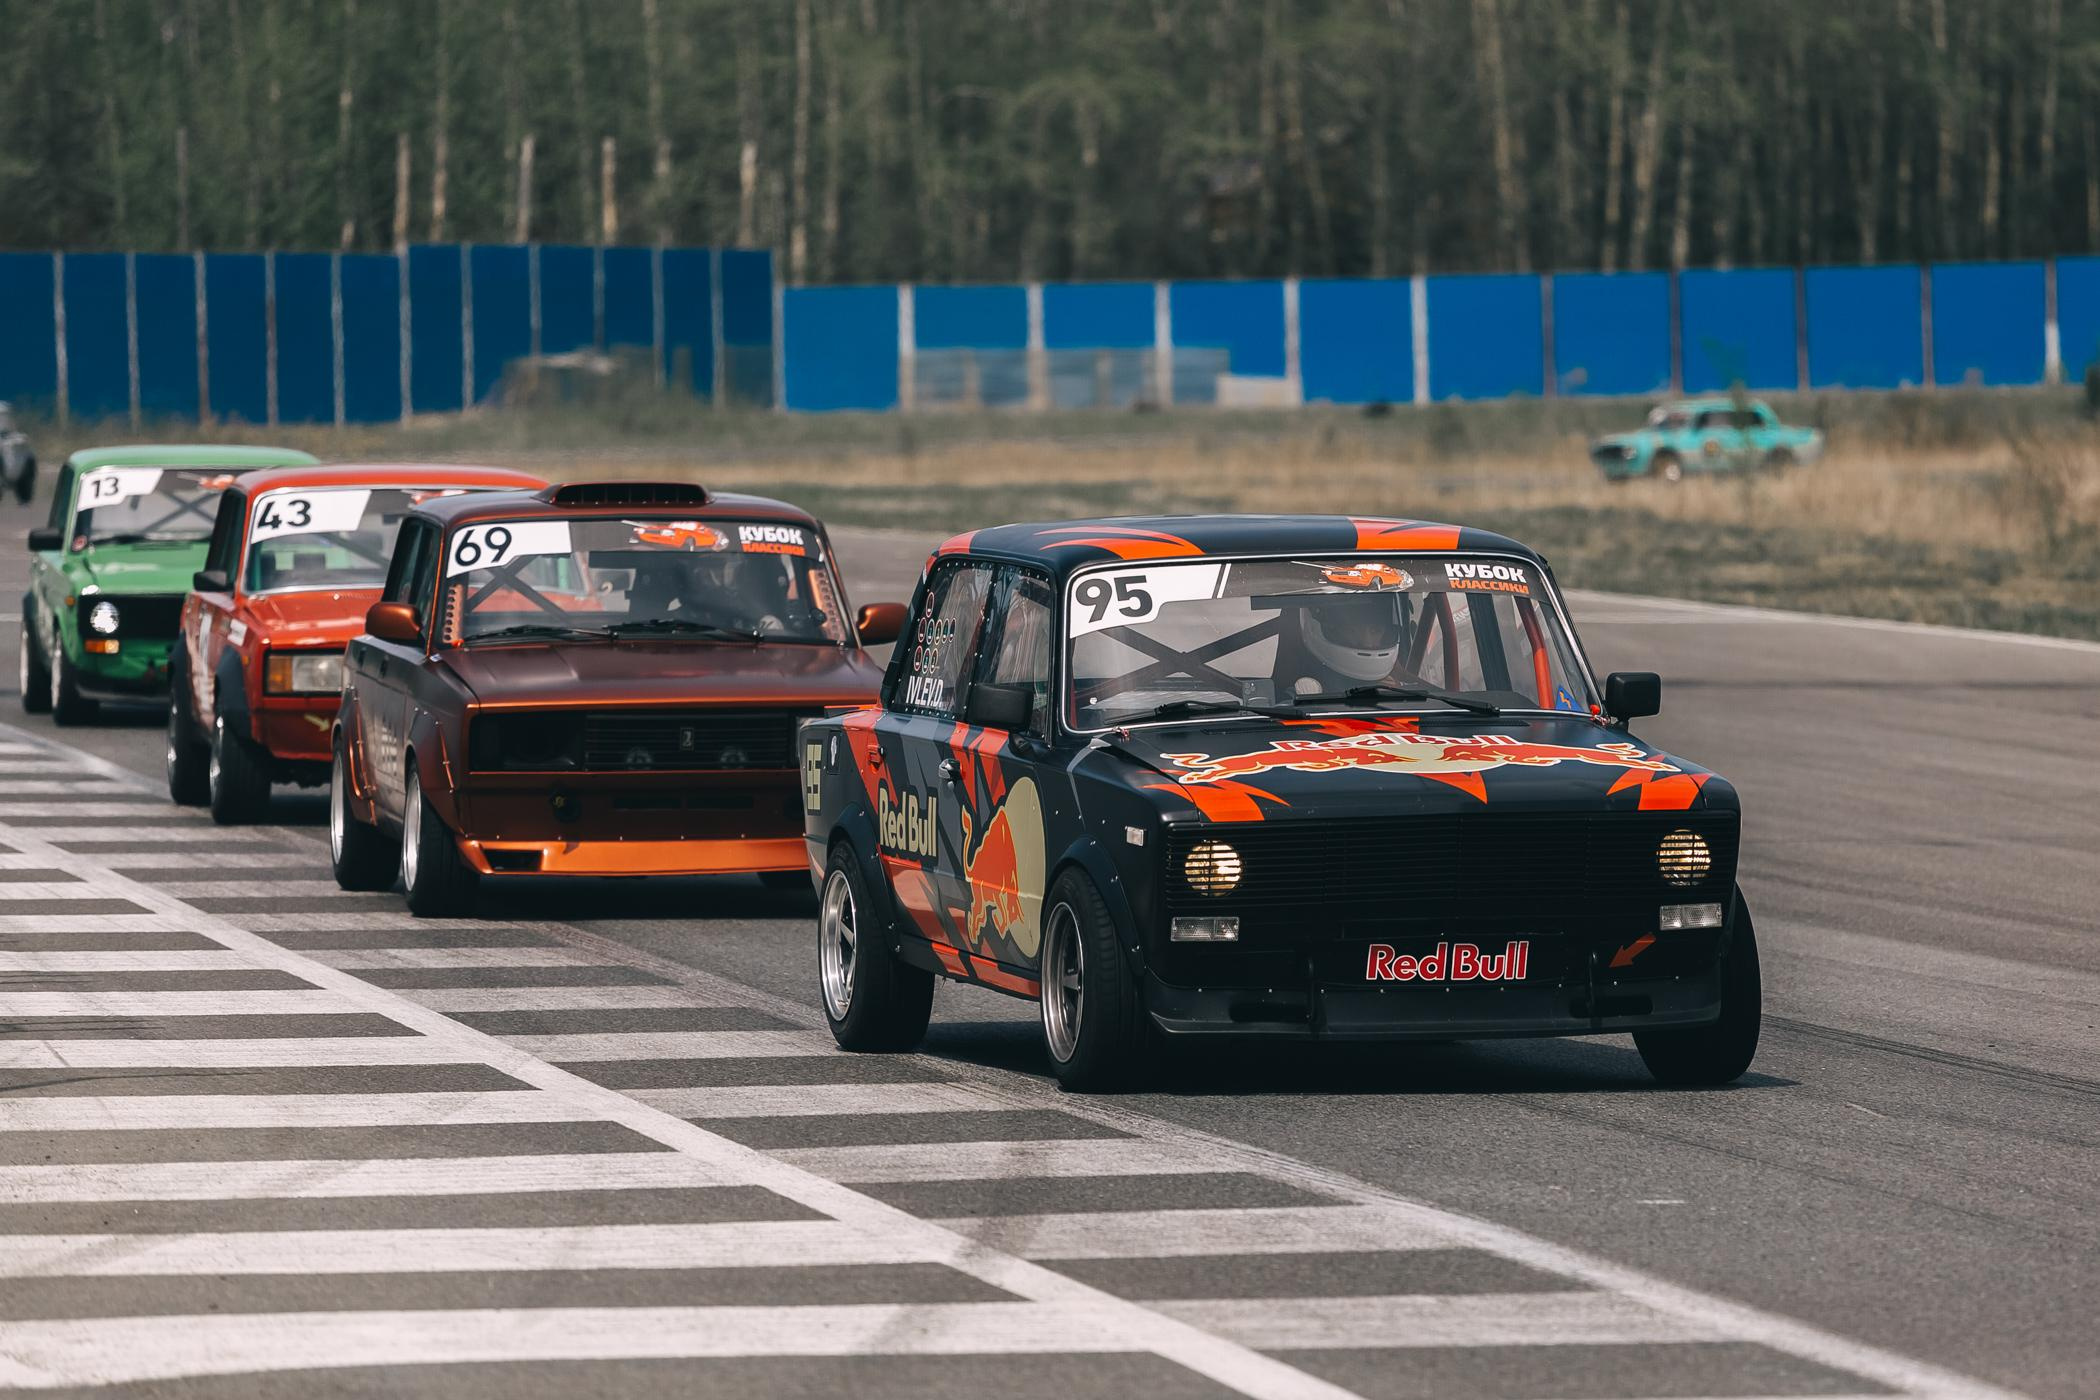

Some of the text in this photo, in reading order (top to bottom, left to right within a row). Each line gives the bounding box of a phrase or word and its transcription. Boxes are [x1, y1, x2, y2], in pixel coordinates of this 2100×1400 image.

[91, 476, 119, 498] 13
[257, 499, 311, 529] 43
[455, 526, 512, 567] 69
[738, 526, 804, 546] КУБОК
[1444, 563, 1527, 583] КУБОК
[1075, 575, 1153, 624] 95
[1449, 578, 1530, 595] КЛАССИКИ
[1269, 734, 1522, 751] Red Bull
[879, 787, 937, 857] Red Bull
[1366, 940, 1529, 981] Red Bull
